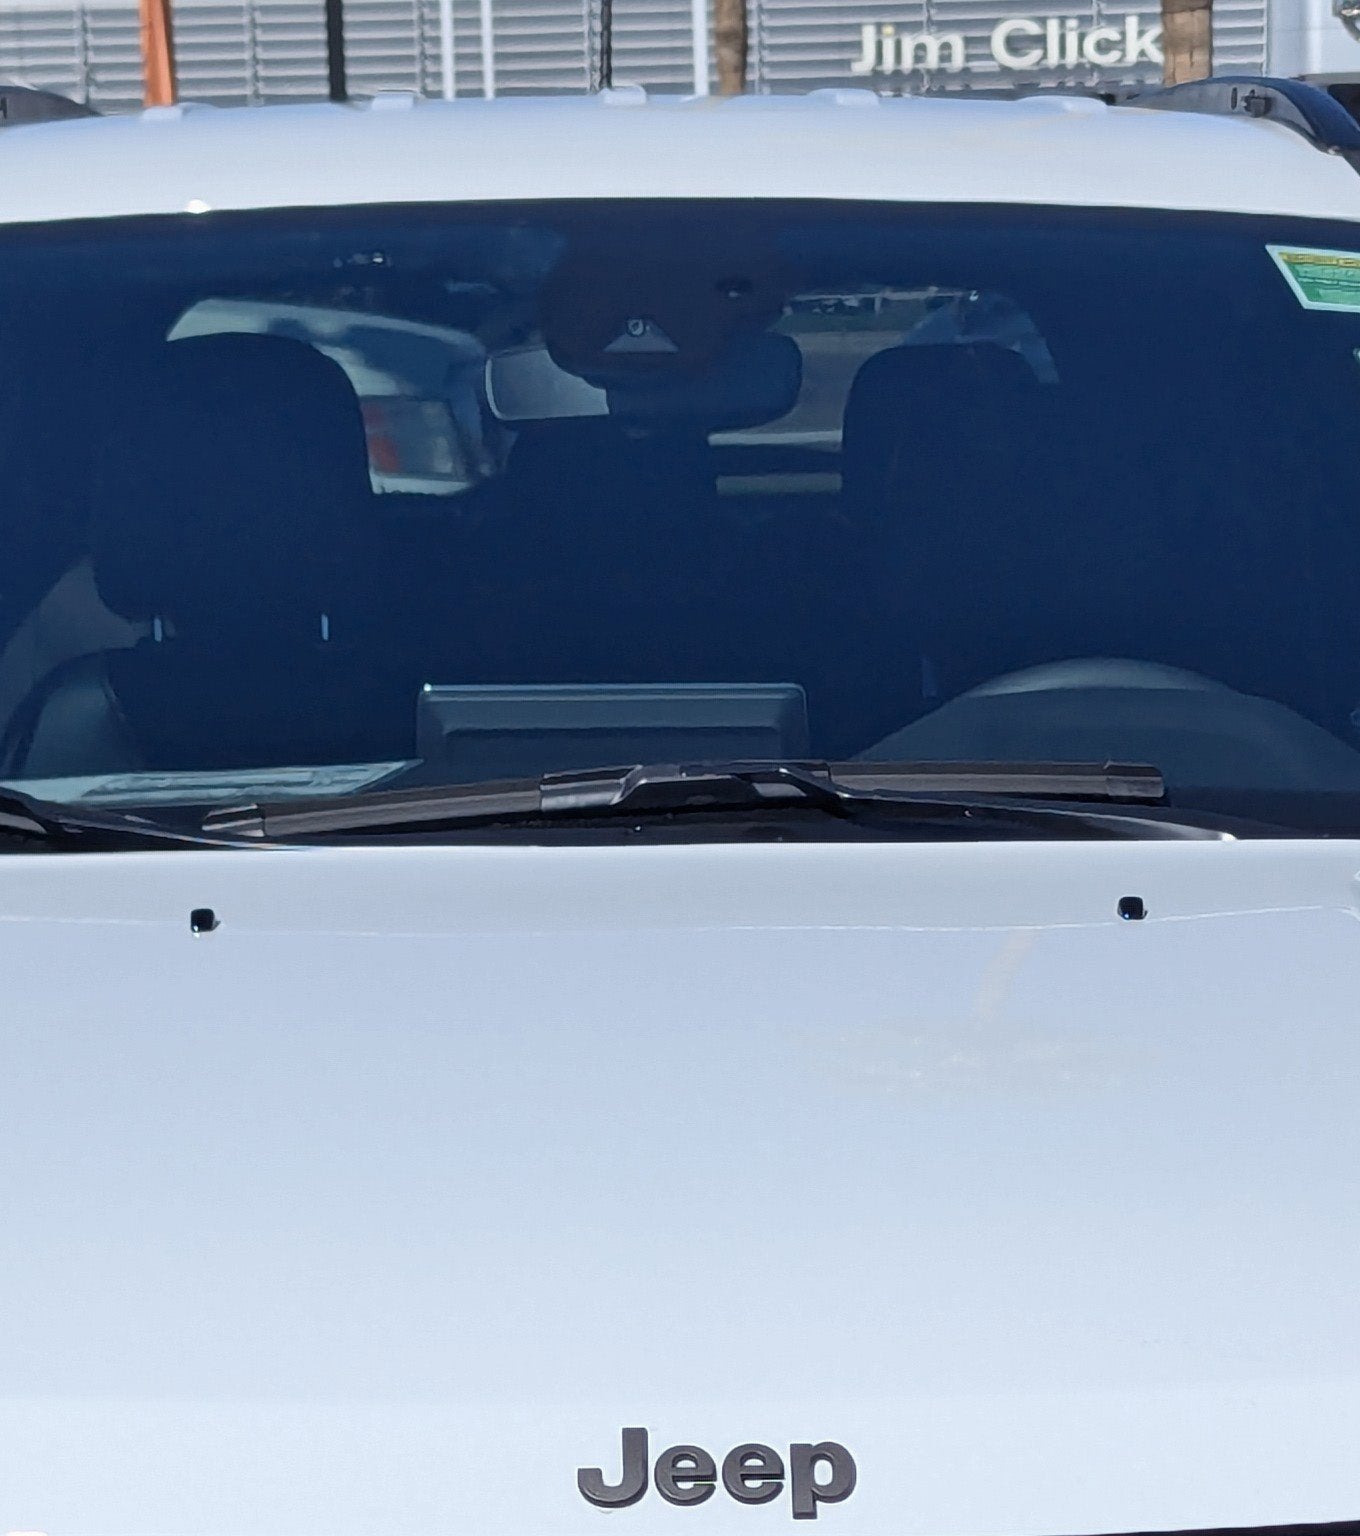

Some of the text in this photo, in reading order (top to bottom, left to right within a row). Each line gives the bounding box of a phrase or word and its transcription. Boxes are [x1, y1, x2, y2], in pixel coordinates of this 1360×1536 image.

[851, 15, 1165, 75] Jim Click
[577, 1427, 857, 1519] Jeep
